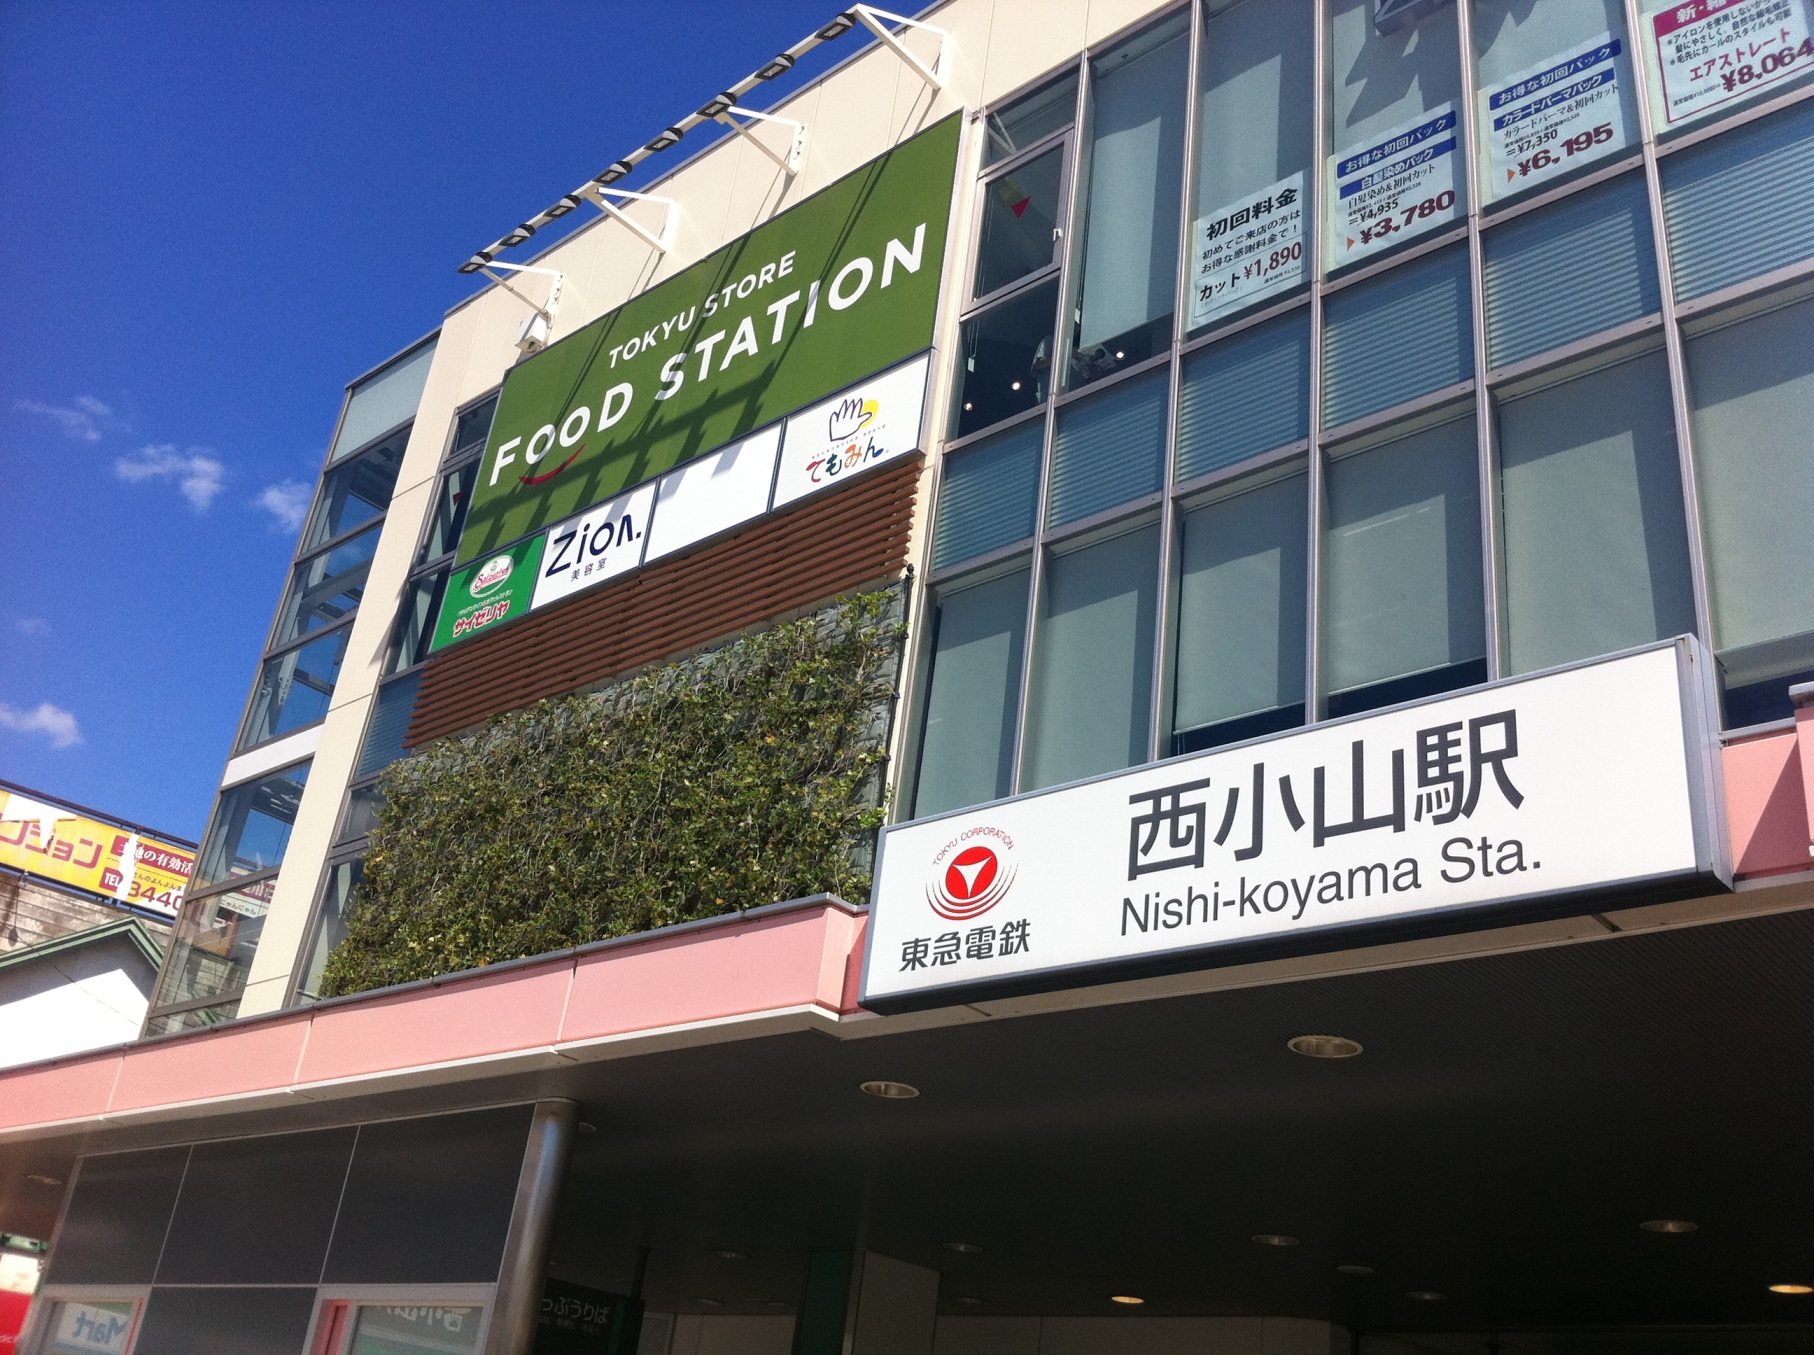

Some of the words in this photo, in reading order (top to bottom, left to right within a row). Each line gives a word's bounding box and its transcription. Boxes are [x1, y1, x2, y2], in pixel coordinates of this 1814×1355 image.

[1499, 48, 1611, 104] お得な初回パック
[1690, 28, 1790, 81] エアストレート
[1345, 119, 1446, 173] お得な初回パック
[1518, 122, 1614, 177] ¥6,195
[1202, 209, 1301, 260] 初めてご来店の方は
[1206, 188, 1297, 240] 初回料金
[1360, 190, 1455, 245] ¥3,780
[1243, 241, 1302, 279] ¥1,890
[608, 307, 694, 369] TOKYU
[702, 251, 796, 317] STORE
[489, 382, 634, 487] FOOD
[655, 223, 926, 400] STATION
[806, 436, 884, 482] てもみん
[571, 557, 607, 582] 美容室
[453, 600, 510, 637] サイゼリヤ
[1127, 708, 1525, 882] 西小山駅
[932, 838, 958, 866] TOKYU
[960, 827, 1015, 850] CORPORATION
[1120, 855, 1422, 936] Nishi-koyama
[1440, 836, 1542, 884] Sta.
[898, 918, 1031, 972] 東急電鉄
